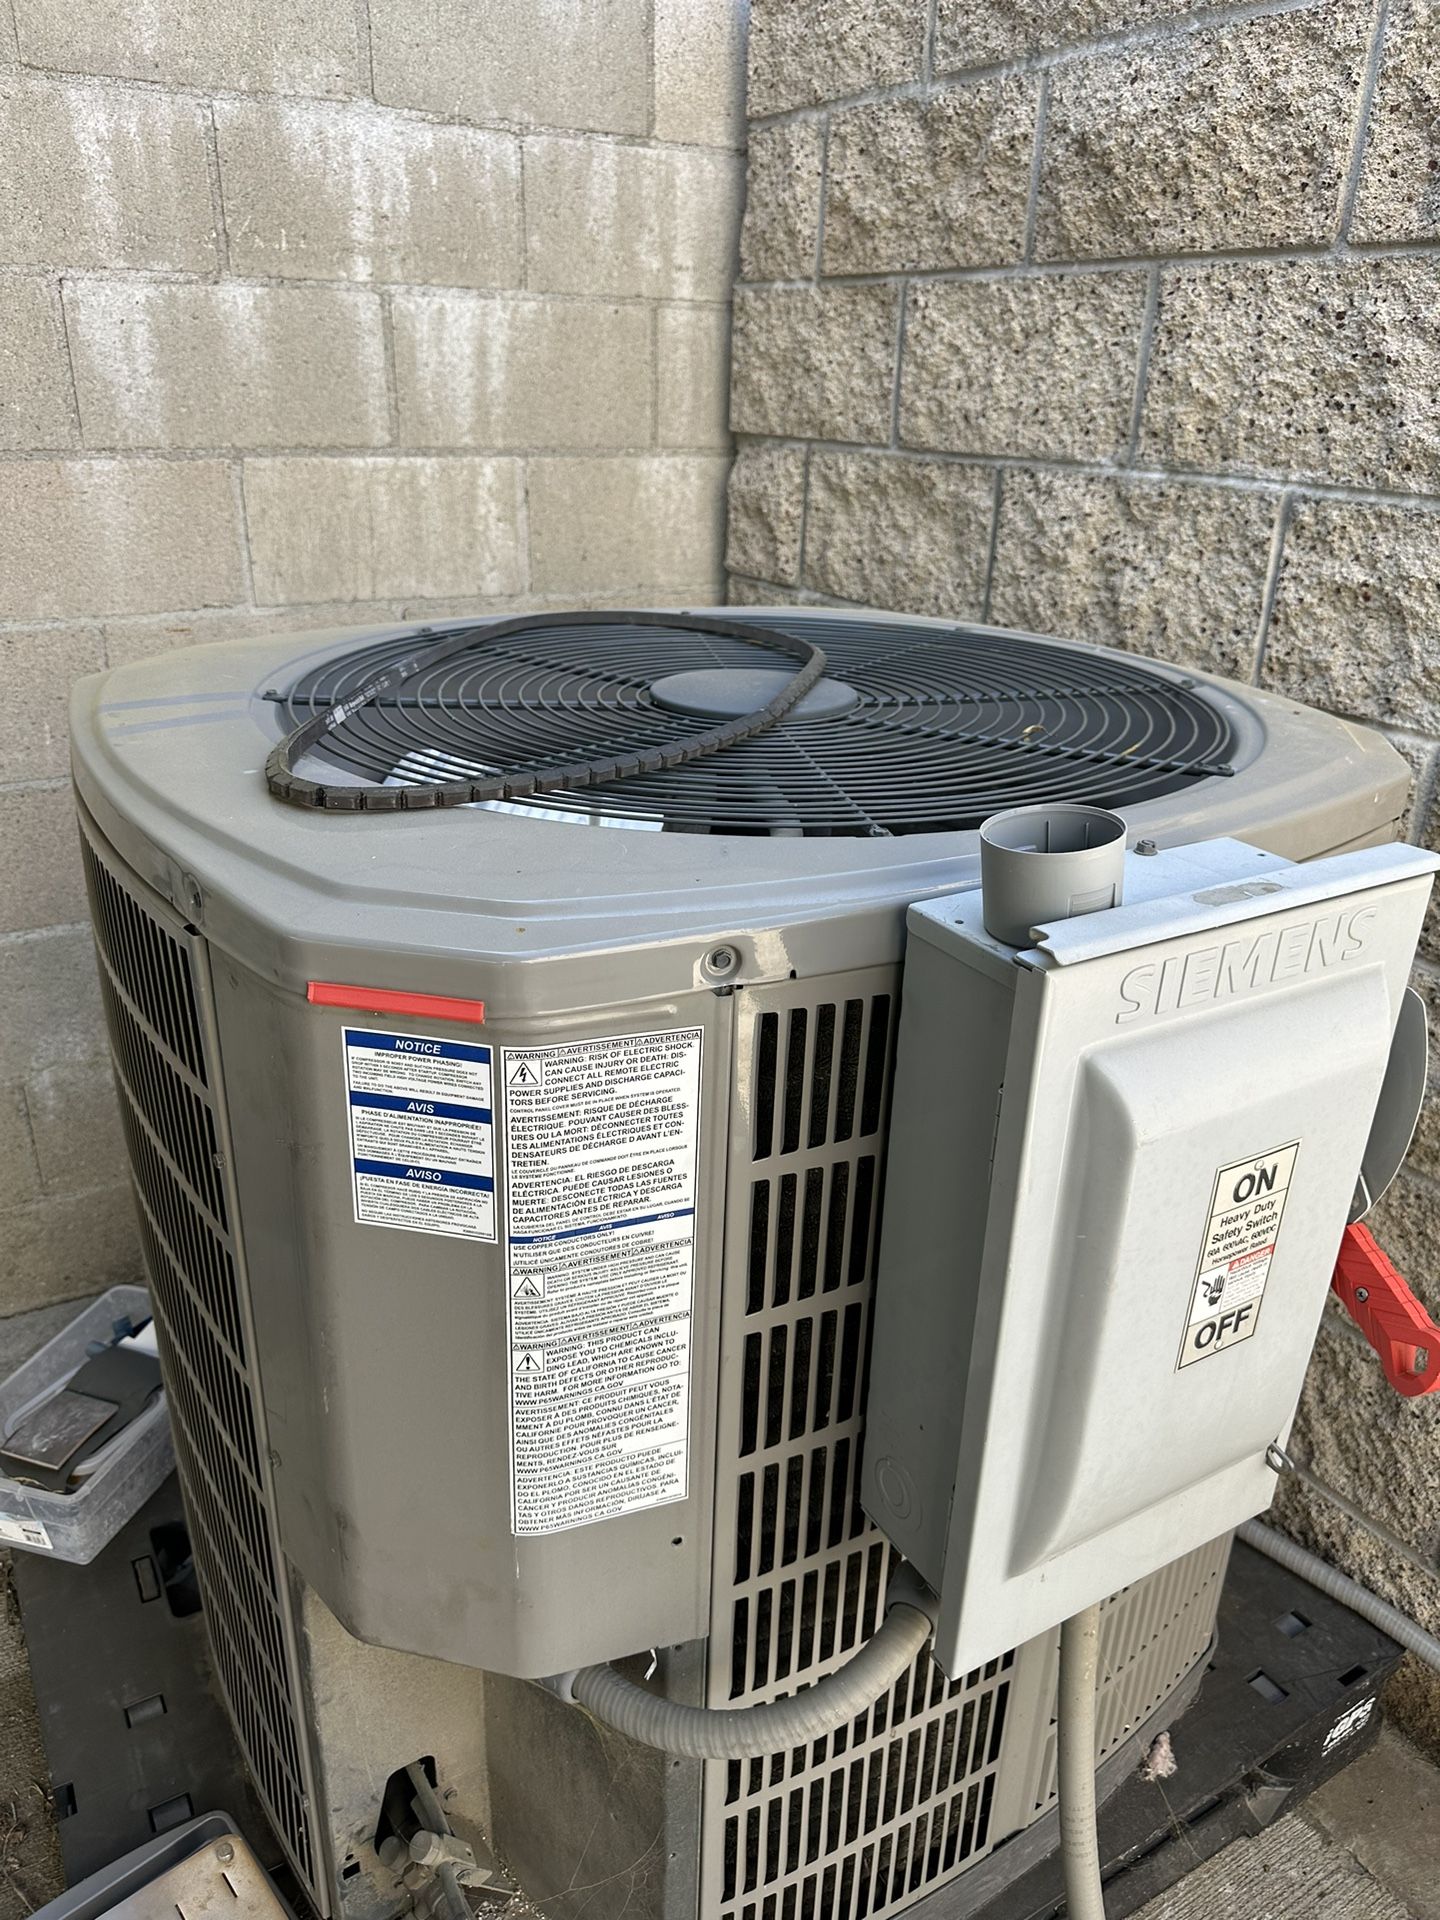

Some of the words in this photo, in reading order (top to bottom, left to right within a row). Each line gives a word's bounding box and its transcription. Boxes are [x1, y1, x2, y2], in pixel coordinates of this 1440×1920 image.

[1115, 904, 1377, 1024] SIEMENS
[394, 1039, 441, 1054] NOTICE
[407, 1055, 431, 1063] POWER
[514, 1049, 555, 1061] WARNING
[565, 1039, 634, 1055] AVERTISSEMENT
[643, 1032, 699, 1044] ADVERTENCIA
[588, 1052, 608, 1061] RISK
[609, 1050, 621, 1058] OF
[623, 1045, 662, 1056] ELECTRIC
[544, 1068, 562, 1076] CAN
[564, 1063, 592, 1073] CAUSE
[594, 1059, 624, 1069] INJURY
[544, 1073, 584, 1085] CONNECT
[586, 1071, 602, 1079] ALL
[604, 1065, 637, 1076] REMOTE
[640, 1060, 678, 1071] ELECTRIC
[509, 1089, 541, 1097] POWER
[543, 1083, 583, 1095] SUPPLIES
[584, 1080, 603, 1088] AND
[604, 1073, 651, 1086] DISCHARGE
[653, 1069, 685, 1078] CAPACI-
[406, 1101, 434, 1113] AVIS
[510, 1098, 533, 1106] TORS
[534, 1094, 569, 1105] BEFORE
[571, 1087, 617, 1099] SERVICING.
[583, 1104, 613, 1115] RISQUE
[615, 1102, 626, 1110] DE
[628, 1095, 672, 1108] DÉCHARGE
[510, 1133, 534, 1141] URES
[535, 1132, 549, 1140] OU
[550, 1130, 562, 1138] LA
[590, 1116, 651, 1131] DÉCONNECTER
[652, 1111, 683, 1121] TOUTES
[567, 1114, 606, 1126] POUVANT
[608, 1108, 641, 1120] CAUSER
[643, 1106, 659, 1114] DES
[660, 1102, 688, 1112] BLESS-
[511, 1142, 527, 1150] LES
[529, 1133, 594, 1149] ALIMENTATIONS
[596, 1124, 651, 1139] ÉLECTRIQUES
[652, 1122, 663, 1130] ET
[664, 1120, 684, 1128] CON-
[511, 1147, 567, 1158] DENSATEURS
[568, 1144, 580, 1152] DE
[582, 1137, 626, 1150] DÉCHARGE
[405, 1167, 441, 1181] AVISO
[511, 1159, 548, 1167] TRETIEN.
[586, 1168, 617, 1179] RIESGO
[618, 1166, 629, 1174] DE
[631, 1159, 674, 1171] DESCARGA
[551, 1187, 605, 1202] DESCONECTE
[607, 1181, 634, 1192] TODAS
[635, 1179, 651, 1187] LAS
[652, 1173, 687, 1184] FUENTES
[562, 1181, 589, 1192] PUEDE
[591, 1175, 624, 1187] CAUSAR
[626, 1168, 664, 1180] LESIONES
[1233, 1165, 1277, 1202] ON
[512, 1210, 570, 1223] CAPACITORES
[571, 1205, 598, 1216] ANTES
[599, 1202, 610, 1210] DE
[612, 1196, 651, 1208] REPARAR.
[525, 1199, 585, 1214] ALIMENTACIÓN
[587, 1191, 631, 1204] ELÉCTRICA
[639, 1182, 682, 1195] DESCARGA
[1220, 1210, 1250, 1227] Heavy
[1253, 1199, 1276, 1214] Duty
[532, 1234, 556, 1243] NOTICE
[1211, 1226, 1246, 1244] Safety
[1245, 1211, 1277, 1230] Switch
[526, 1242, 553, 1250] COPPER
[553, 1234, 596, 1246] CONDUCTORS
[1239, 1246, 1270, 1265] DANGER
[518, 1338, 557, 1351] WARNING
[567, 1322, 630, 1343] AVERTISSEMENT
[637, 1310, 689, 1327] ADVERTENCIA
[587, 1338, 604, 1347] THIS
[605, 1329, 642, 1343] PRODUCT
[643, 1326, 659, 1334] CAN
[1194, 1304, 1252, 1348] OFF
[545, 1352, 577, 1364] EXPOSE
[578, 1348, 595, 1357] YOU
[608, 1335, 652, 1350] CHEMICALS
[653, 1330, 678, 1340] INCLU-
[546, 1362, 565, 1372] DING
[590, 1351, 616, 1361] WHICH
[617, 1347, 633, 1356] ARE
[635, 1341, 663, 1351] KNOWN
[532, 1372, 556, 1382] STATE
[557, 1369, 568, 1377] OF
[570, 1359, 616, 1374] CALIFORNIA
[629, 1350, 654, 1361] CAUSE
[655, 1343, 686, 1354] CANCER
[533, 1380, 557, 1390] BIRTH
[558, 1371, 593, 1385] DEFECTS
[594, 1368, 606, 1376] OR
[607, 1362, 634, 1373] OTHER
[635, 1353, 678, 1367] REPRODUC-
[581, 1396, 592, 1404] CE
[593, 1388, 627, 1401] PRODUIT
[628, 1383, 647, 1393] PEUT
[649, 1379, 669, 1388] VOUS
